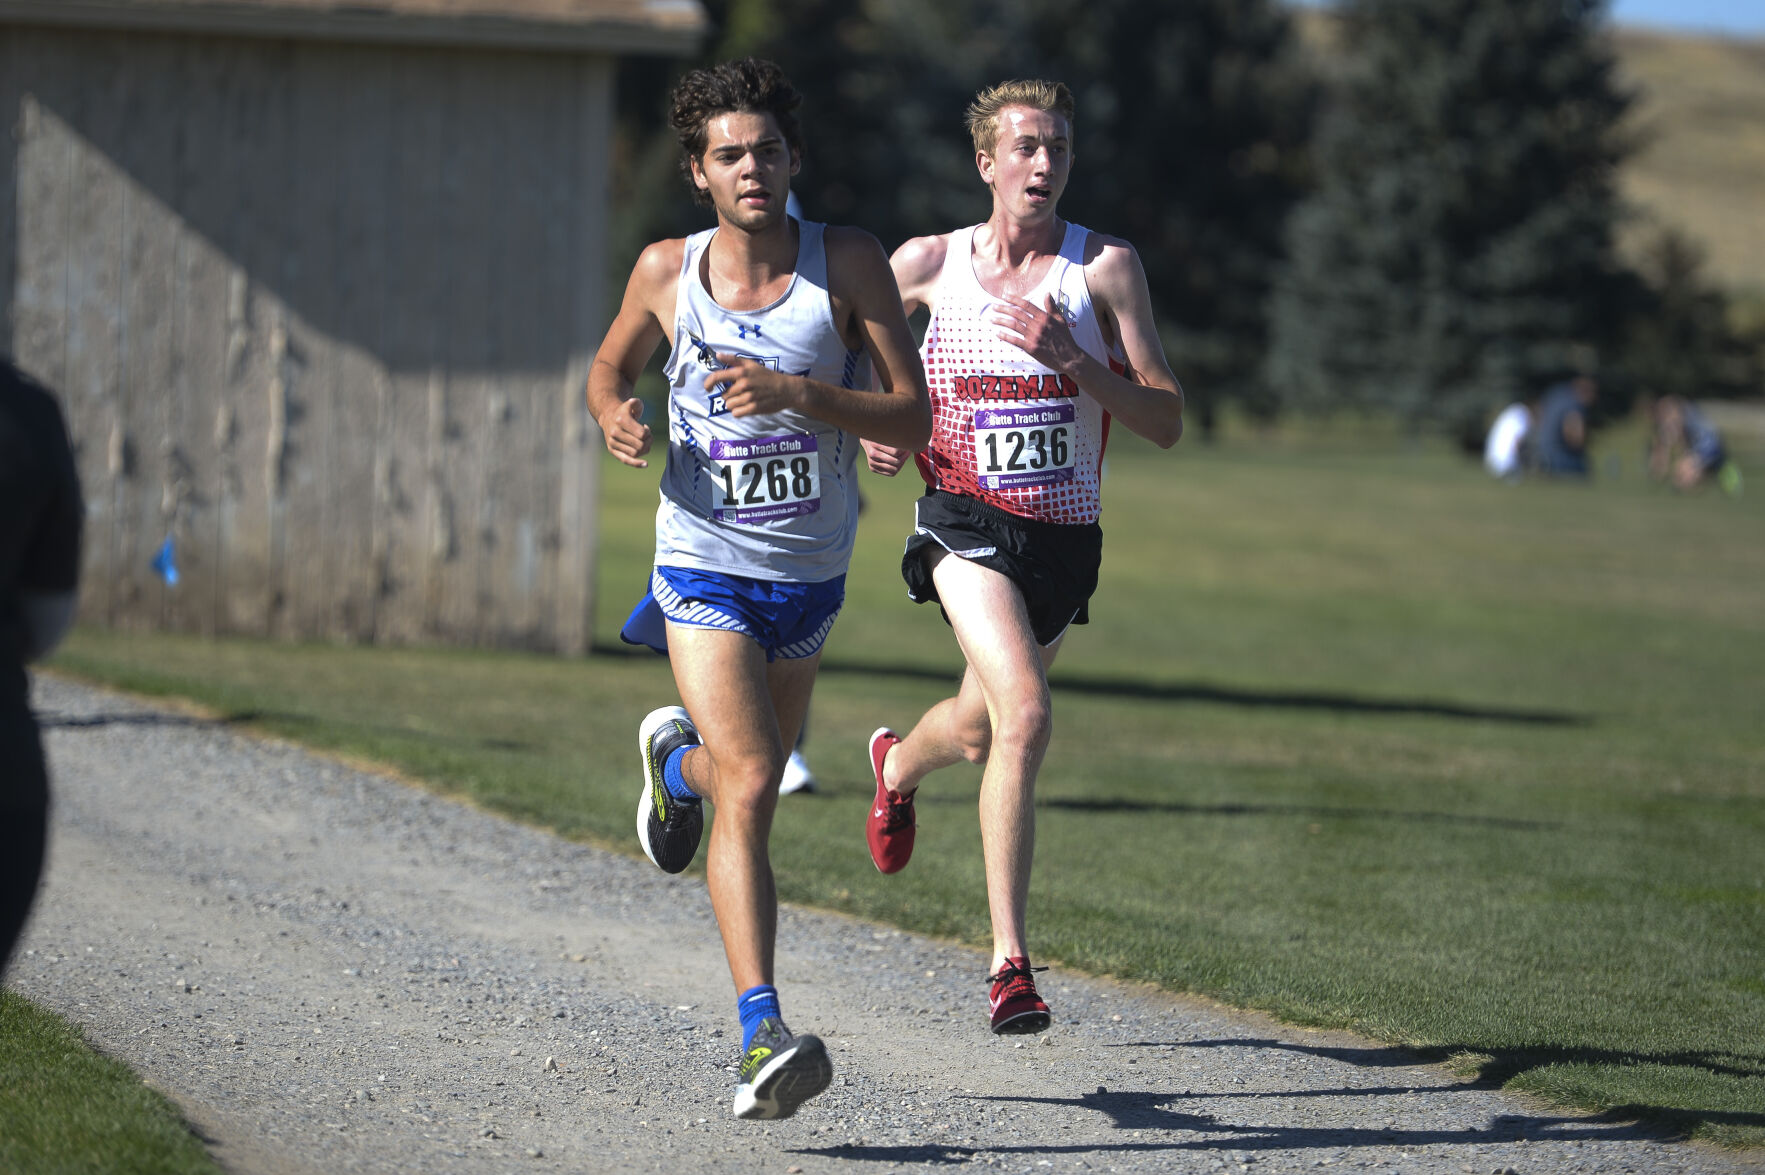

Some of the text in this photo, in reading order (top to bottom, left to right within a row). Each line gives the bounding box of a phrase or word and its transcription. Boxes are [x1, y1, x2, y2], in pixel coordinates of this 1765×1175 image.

[989, 410, 1061, 426] Butte Track Club
[723, 440, 802, 457] Butte Track Club
[985, 426, 1068, 472] 1236
[720, 456, 812, 506] 1268
